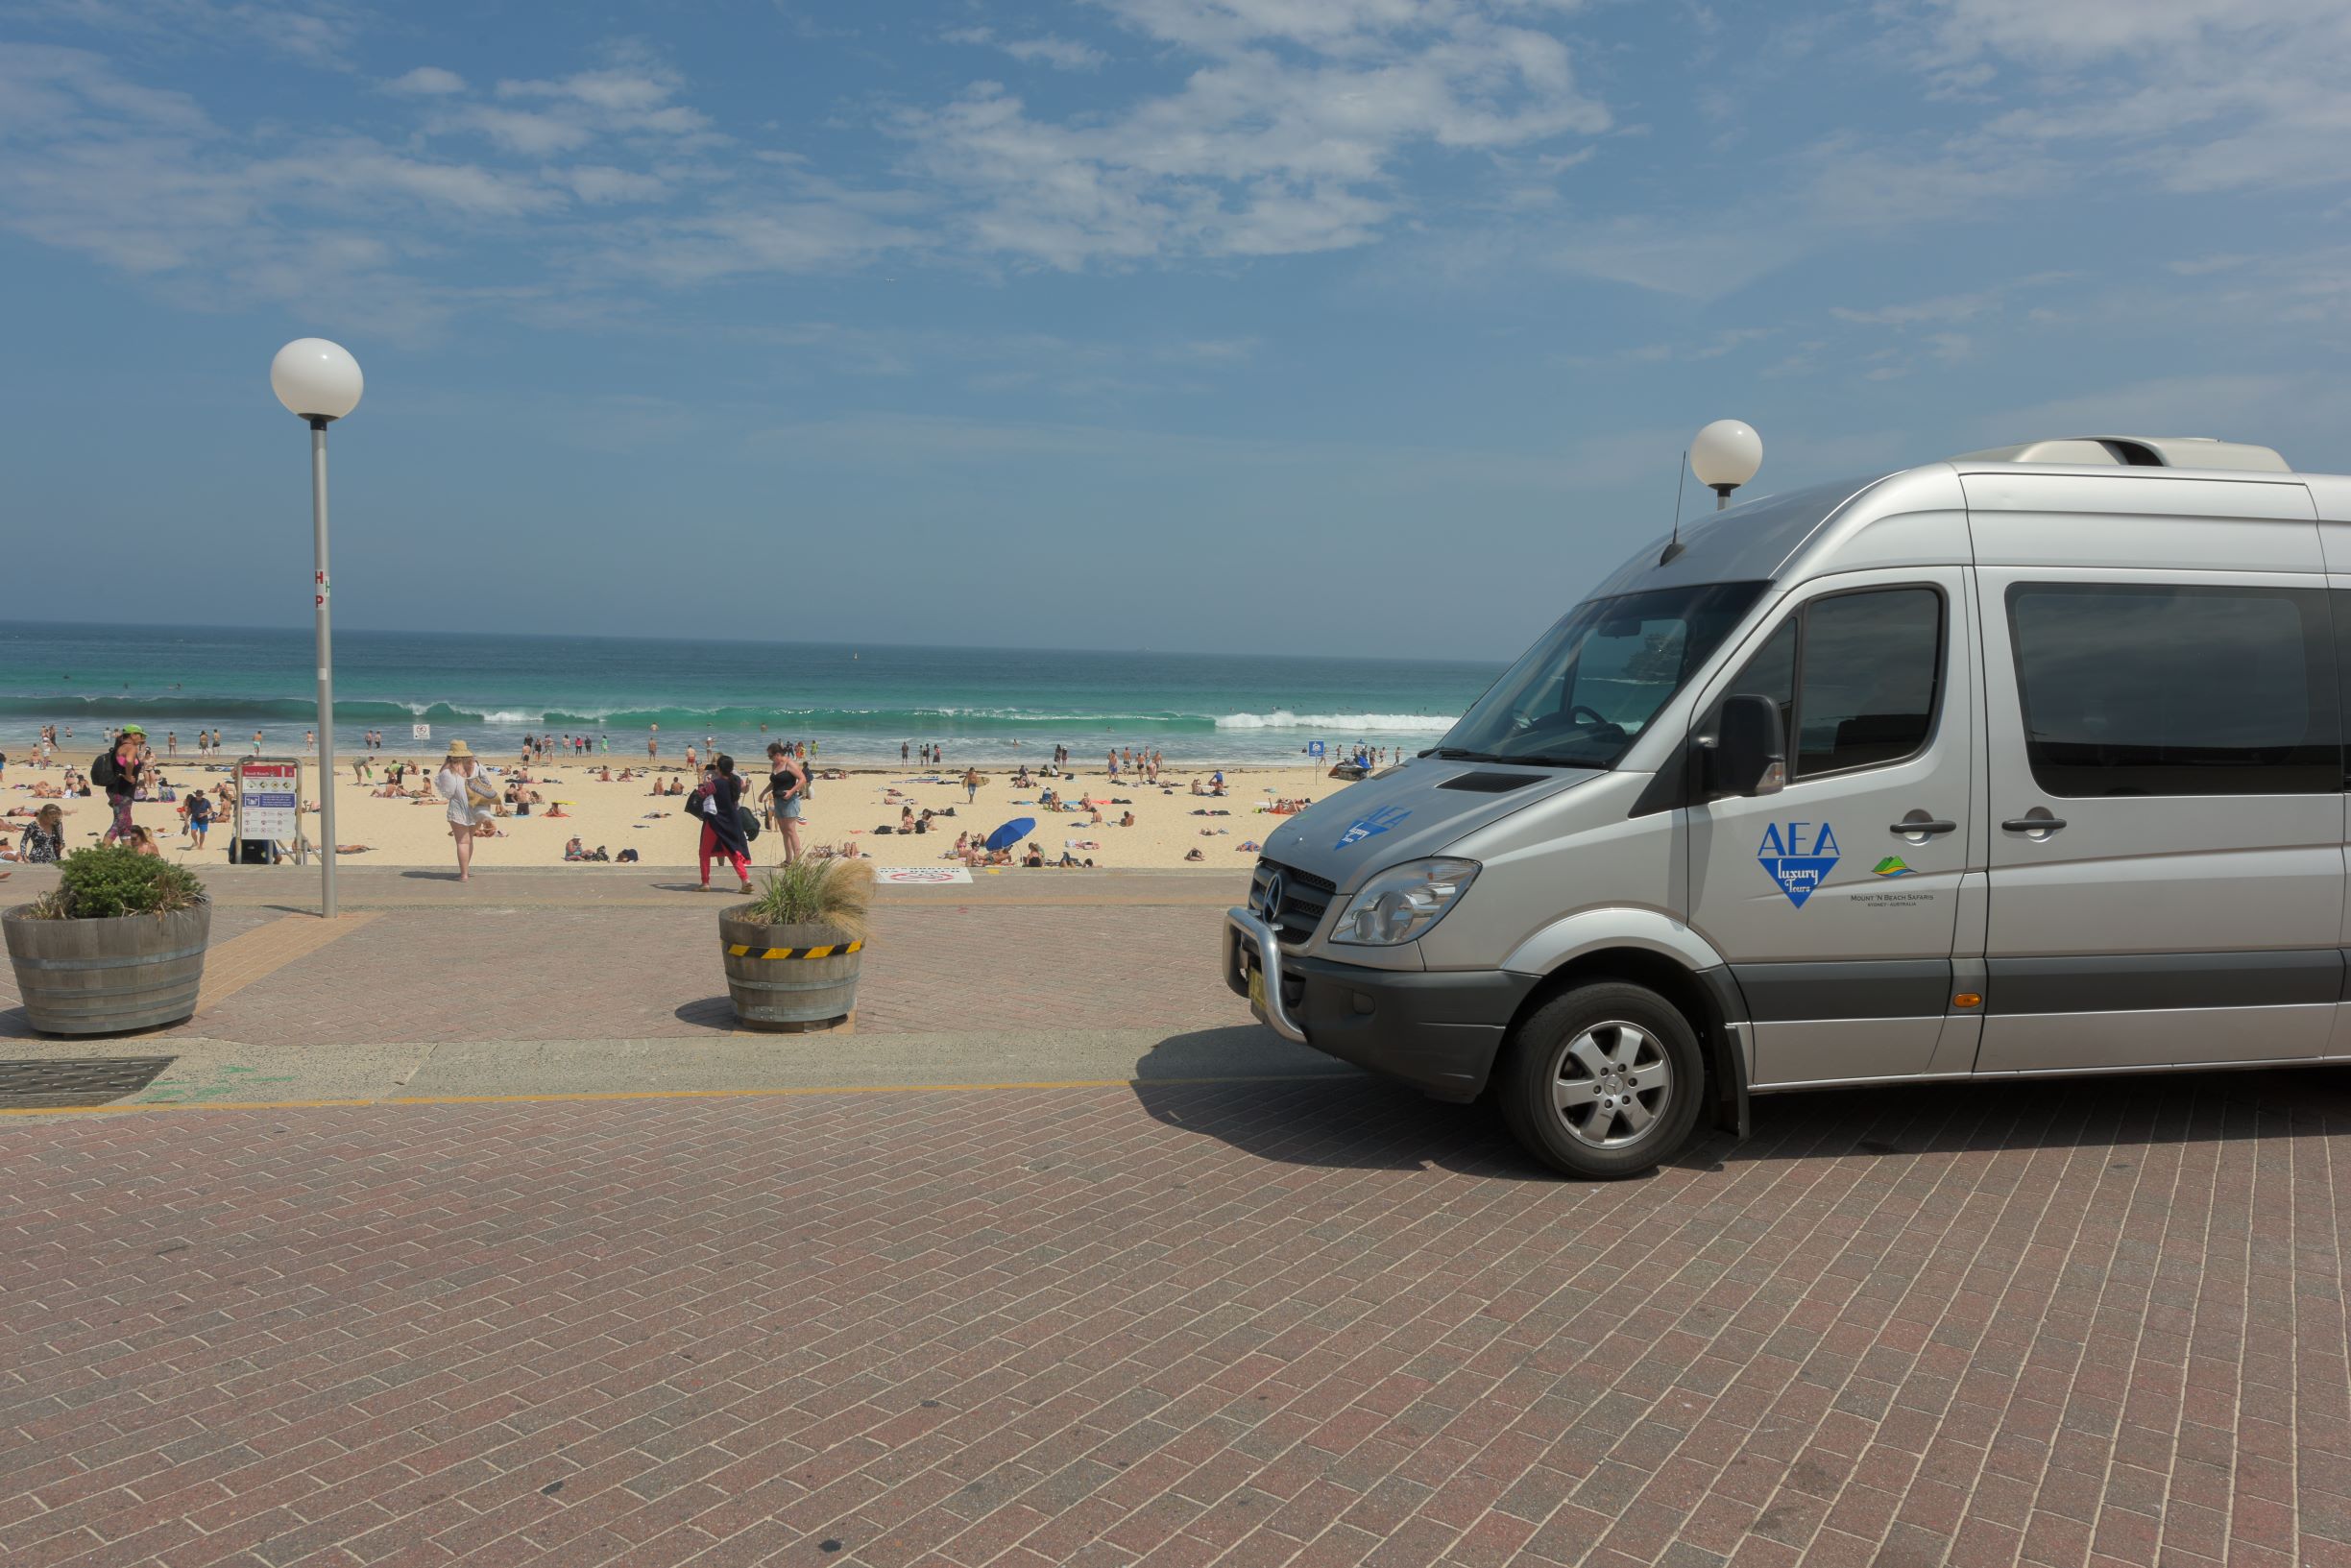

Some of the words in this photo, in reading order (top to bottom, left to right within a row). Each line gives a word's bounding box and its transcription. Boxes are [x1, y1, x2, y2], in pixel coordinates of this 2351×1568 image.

[315, 570, 324, 585] H
[315, 594, 324, 609] P
[1757, 822, 1840, 856] AEA
[1784, 878, 1810, 893] Tours
